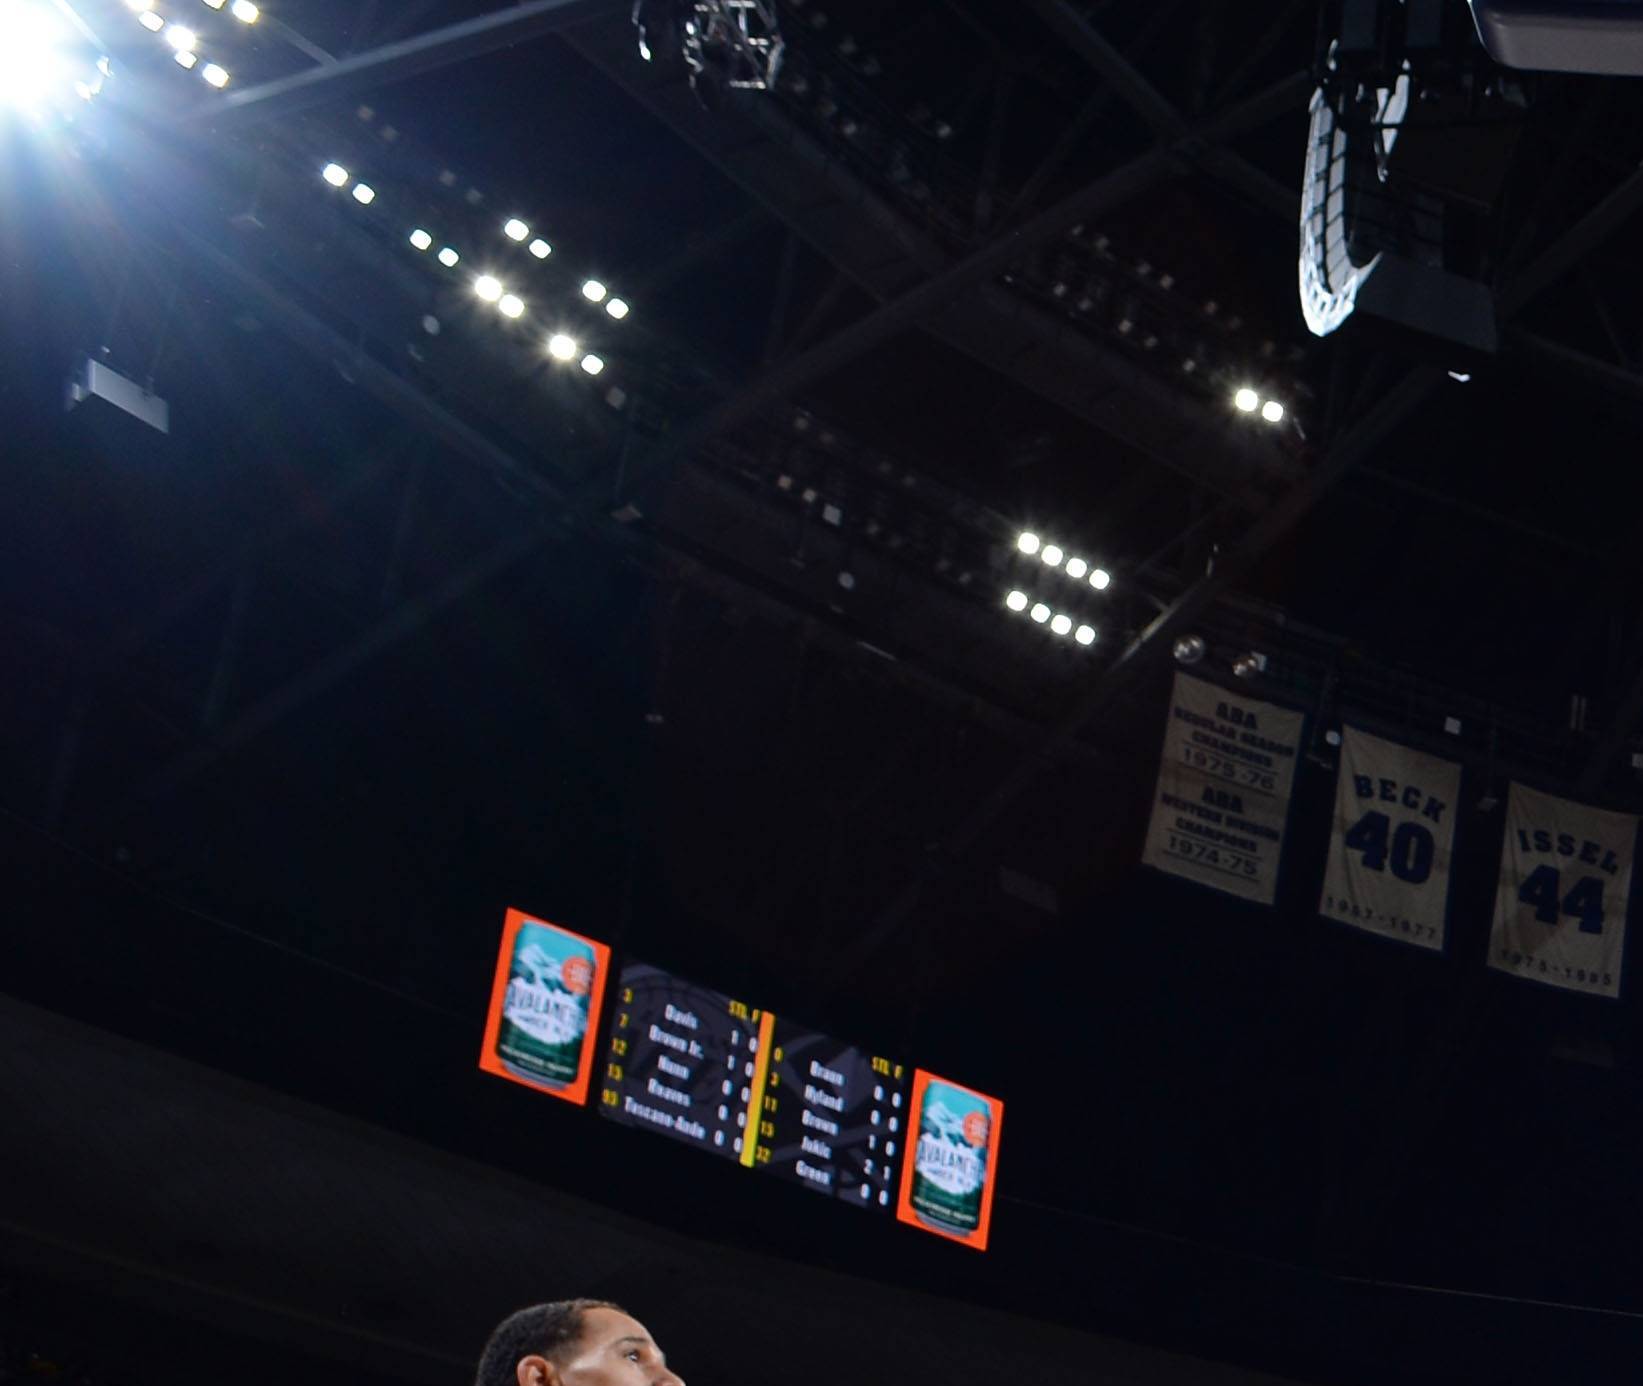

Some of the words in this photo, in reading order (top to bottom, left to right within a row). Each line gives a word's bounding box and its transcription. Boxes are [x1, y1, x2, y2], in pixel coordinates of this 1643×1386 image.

[1354, 774, 1447, 824] BECK
[1345, 810, 1435, 885] 40
[1518, 829, 1619, 876] ISSEL
[1518, 864, 1605, 935] 44
